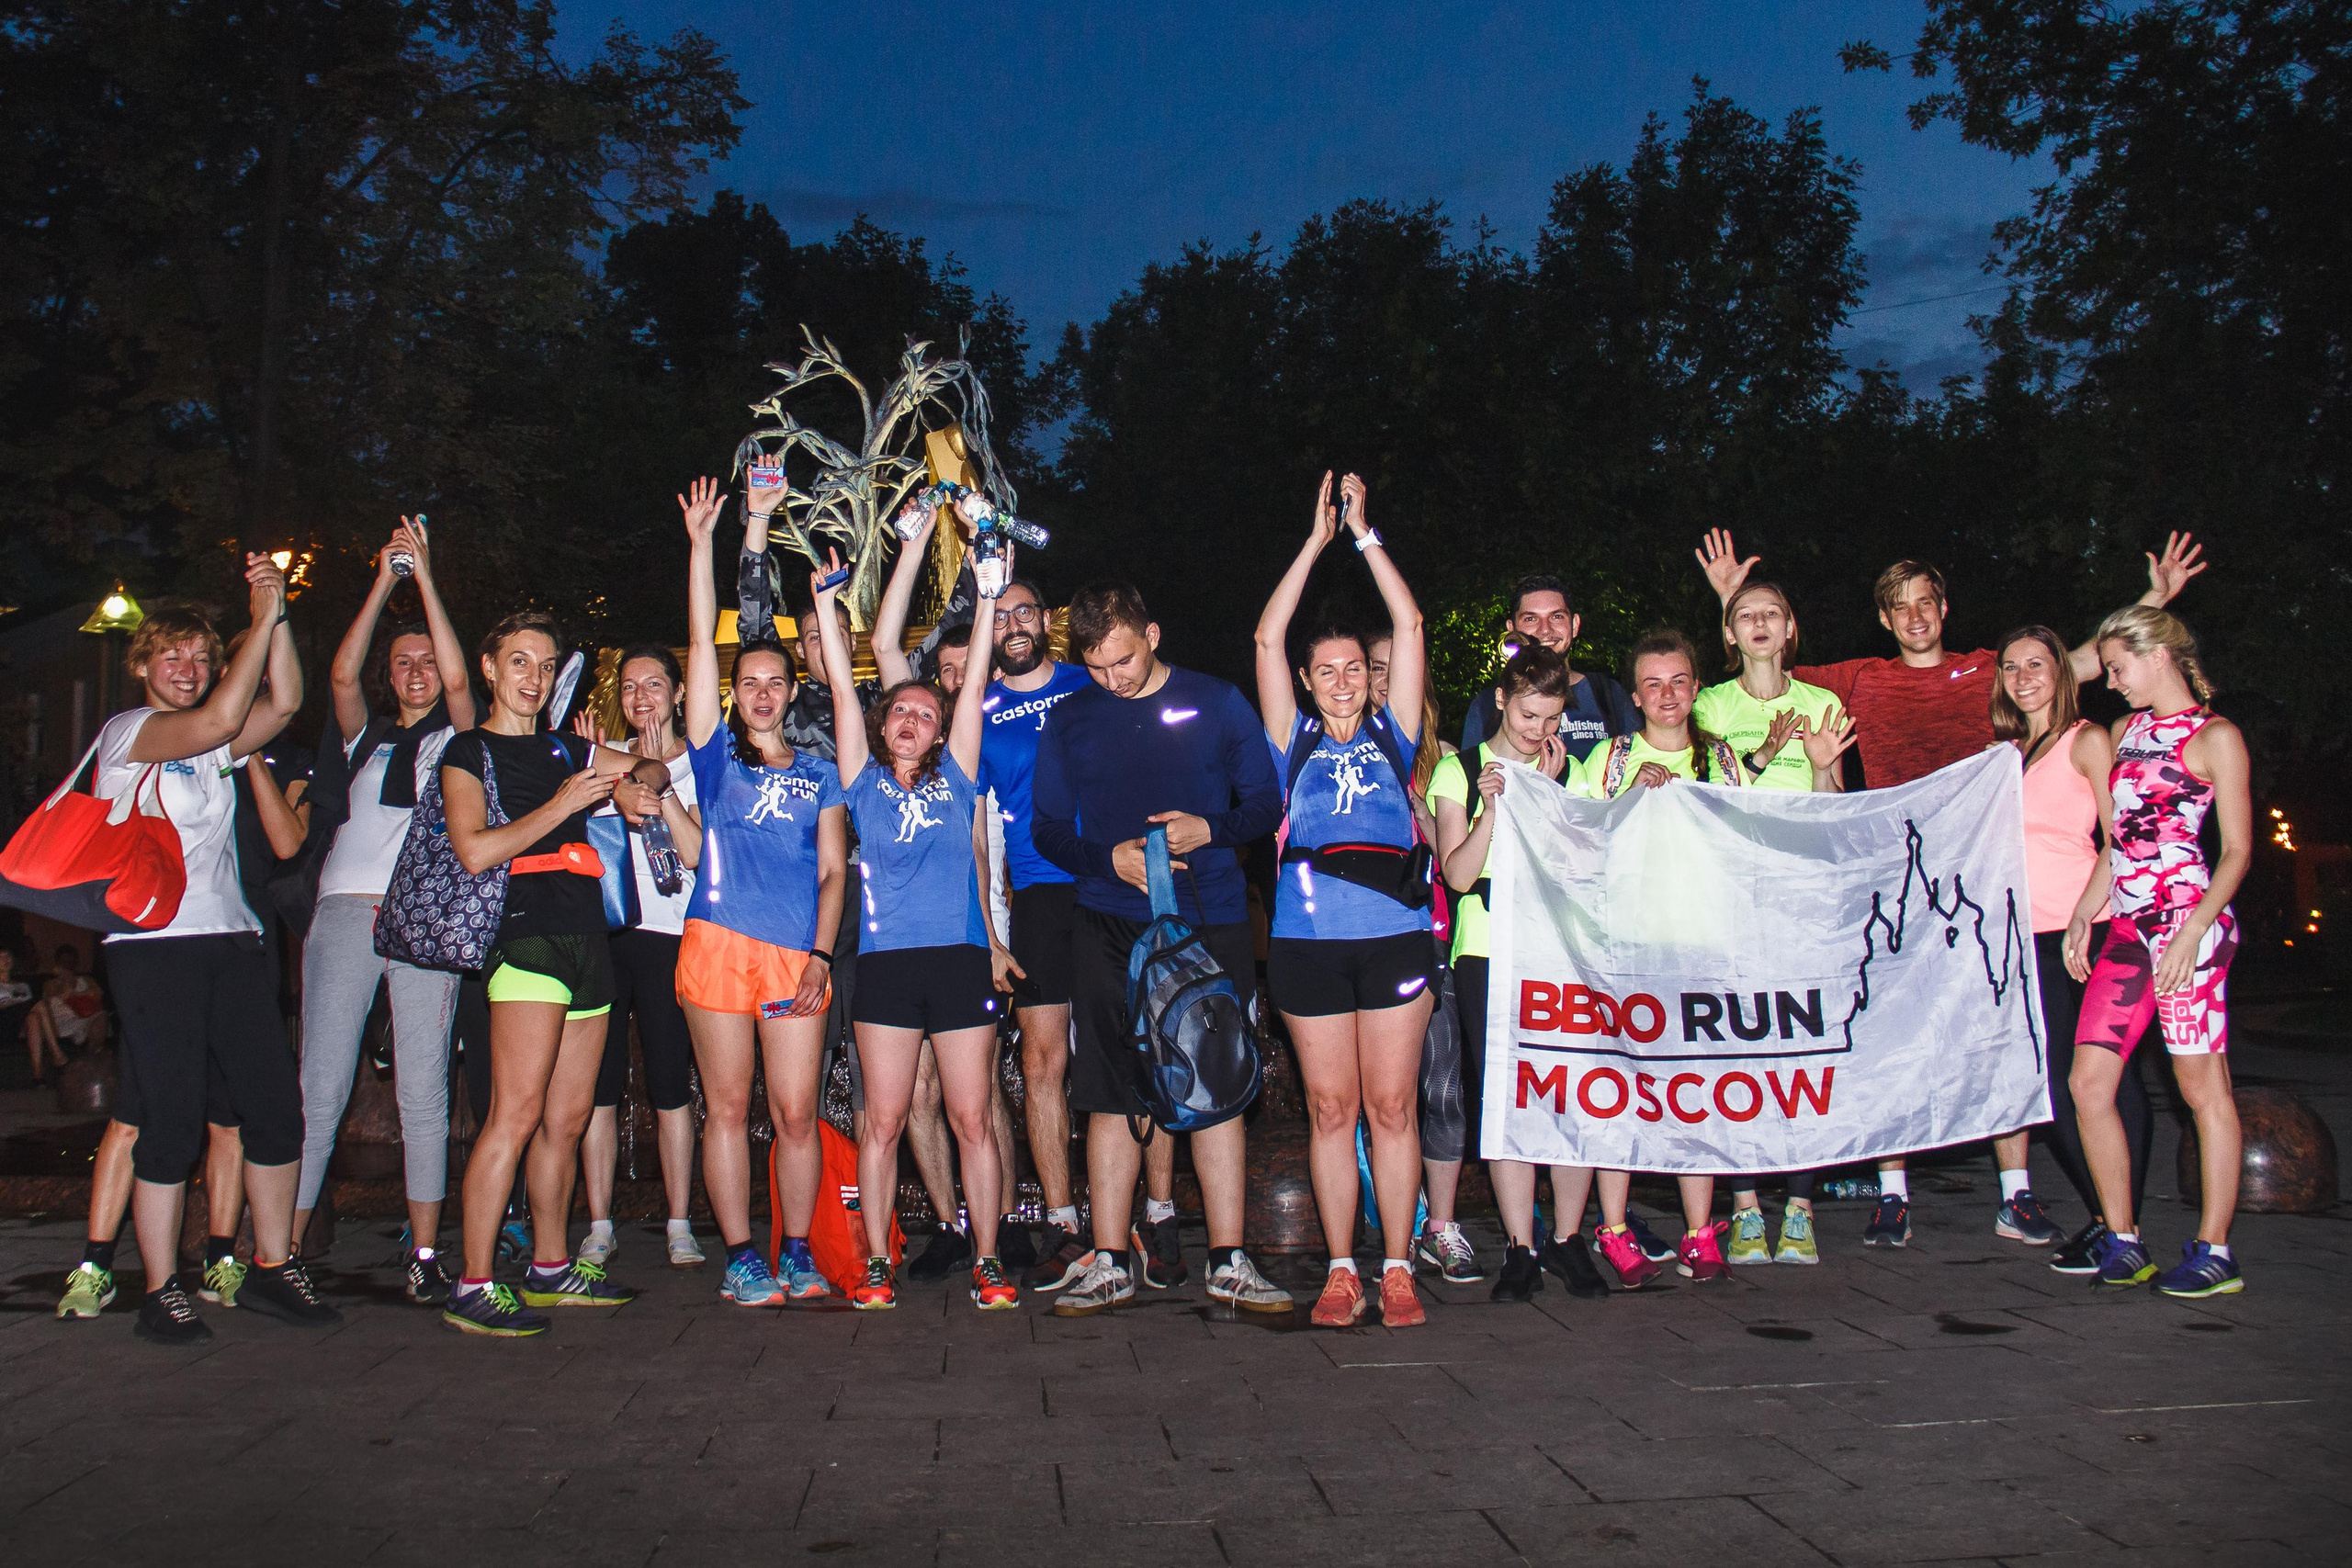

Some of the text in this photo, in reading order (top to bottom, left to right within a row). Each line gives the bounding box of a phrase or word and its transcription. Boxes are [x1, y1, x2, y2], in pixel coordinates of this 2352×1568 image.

[991, 691, 1073, 725] castor
[1572, 731, 1594, 740] since
[1360, 751, 1389, 764] run
[792, 786, 819, 806] run
[925, 789, 954, 802] run
[1519, 979, 1825, 1043] BBDO RUN
[1515, 1059, 1836, 1124] MOSCOW
